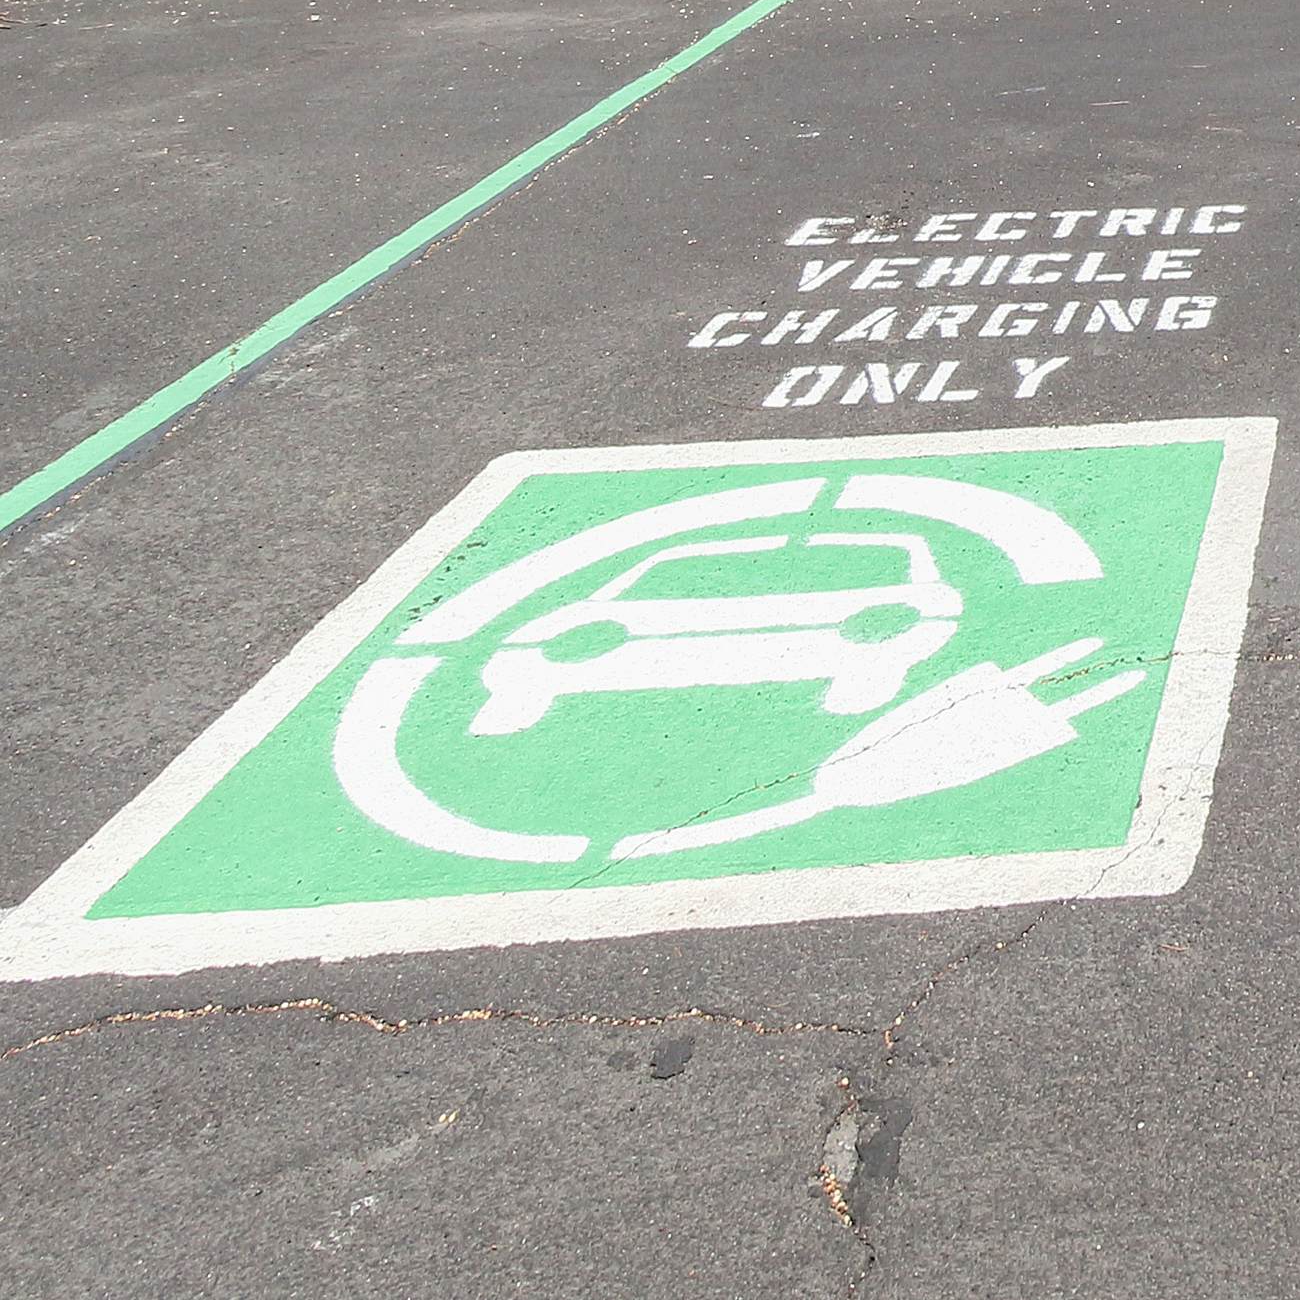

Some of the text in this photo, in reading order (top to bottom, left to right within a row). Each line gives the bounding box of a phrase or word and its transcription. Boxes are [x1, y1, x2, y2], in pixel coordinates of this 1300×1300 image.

[784, 204, 1248, 246] ELECTRIC
[797, 248, 1202, 292] VEHICLE
[686, 296, 1218, 348] CHARGING
[761, 356, 1071, 408] ONLY
